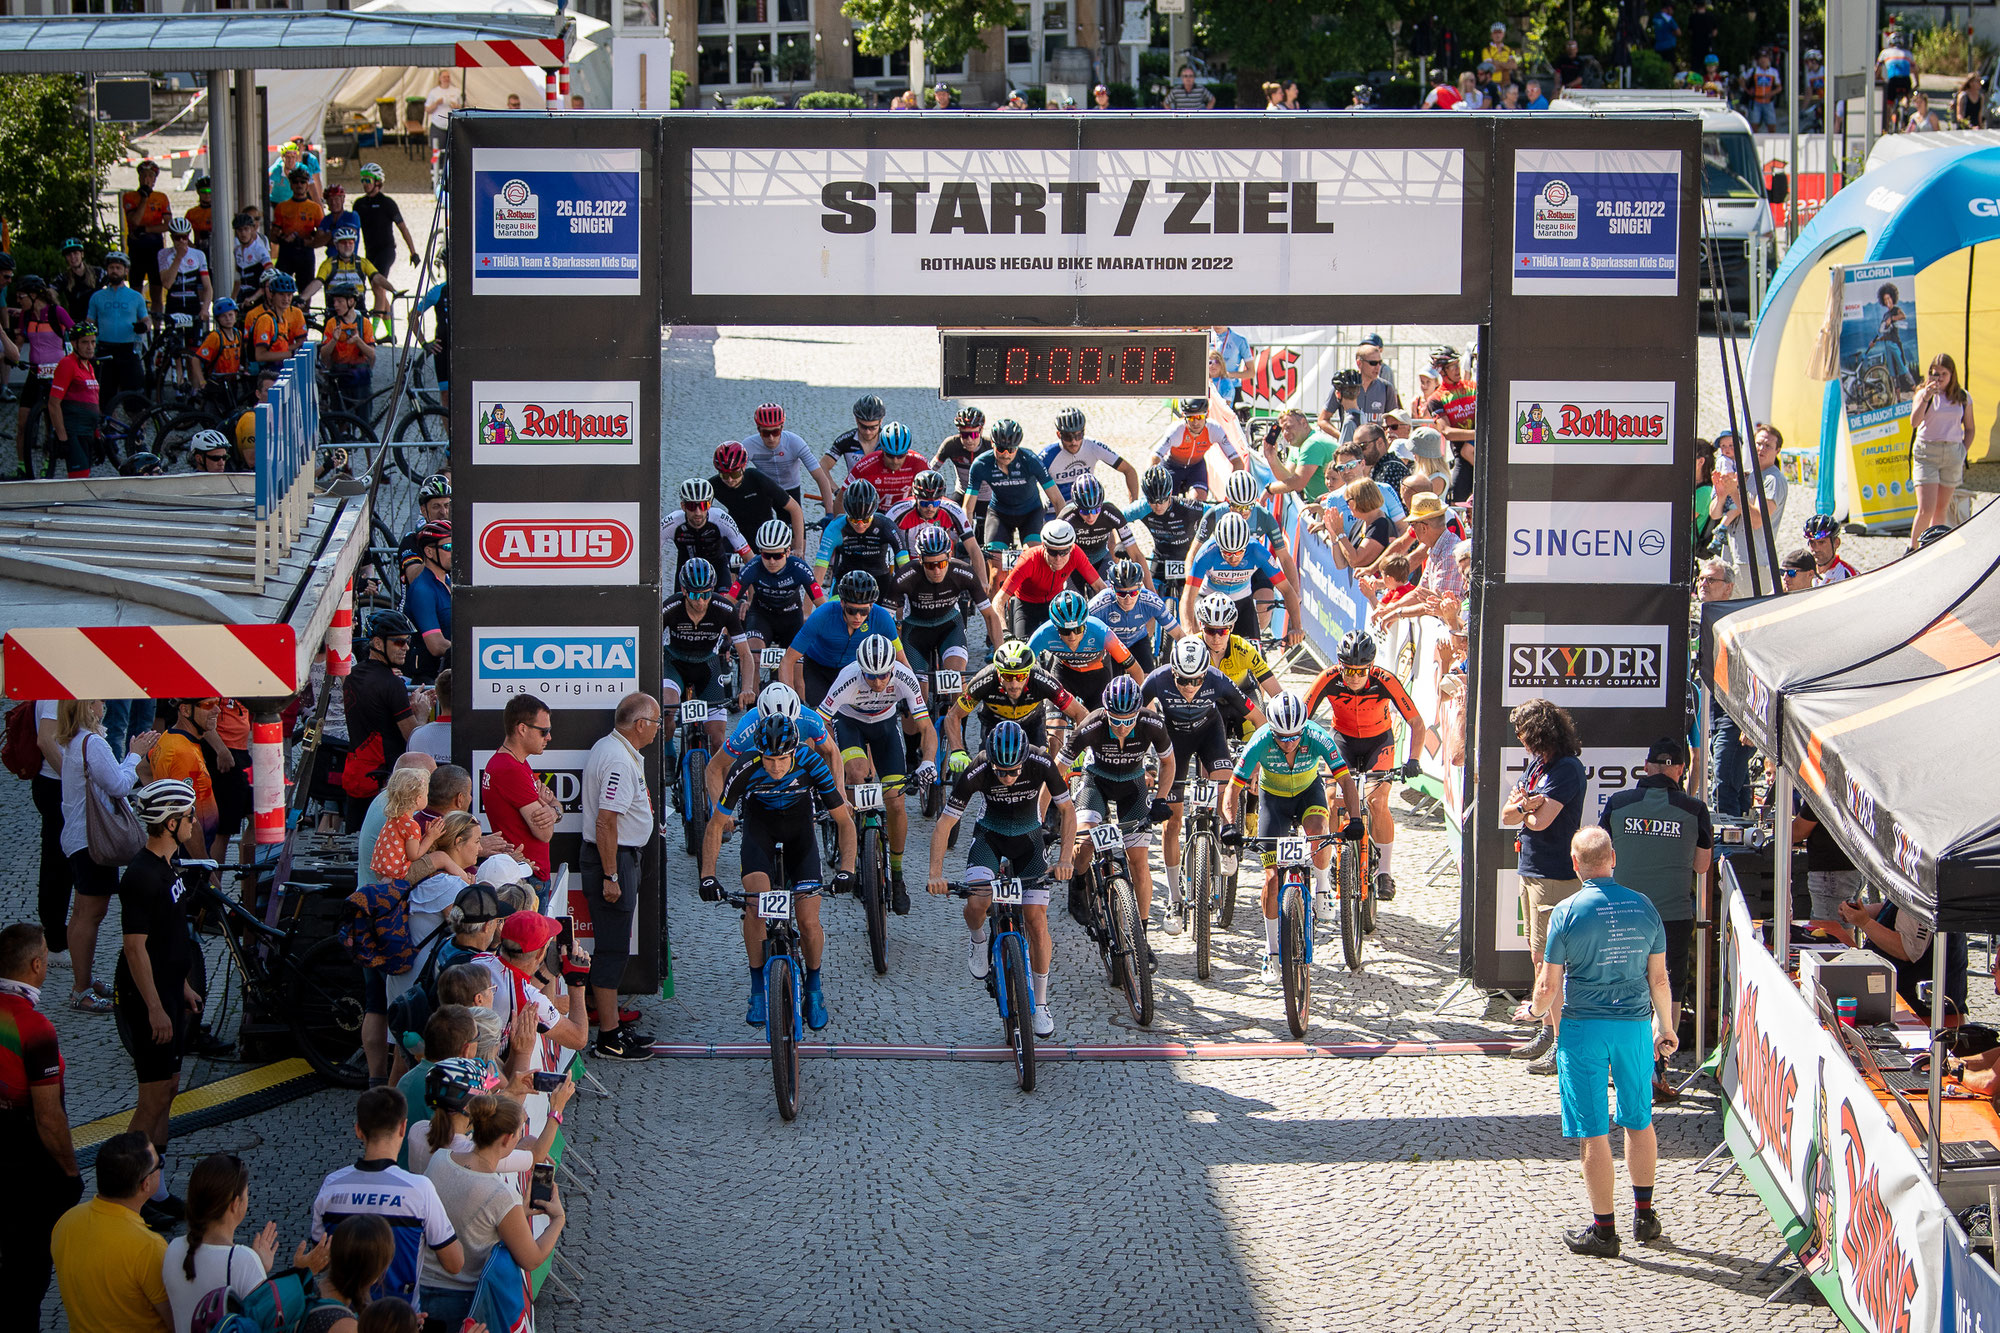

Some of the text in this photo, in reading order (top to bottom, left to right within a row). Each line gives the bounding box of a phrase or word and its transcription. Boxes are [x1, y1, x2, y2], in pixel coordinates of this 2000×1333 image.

[507, 209, 535, 220] Rothaus
[556, 200, 627, 217] 26.06.2022
[821, 180, 1100, 235] START
[1163, 181, 1334, 235] ZIEL
[1547, 210, 1575, 220] Rothaus
[1596, 201, 1665, 217] 26.06.2022
[495, 222, 536, 230] Hegau Bike
[497, 229, 534, 237] Marathon
[570, 217, 613, 234] SINGEN
[1536, 223, 1576, 231] Hegau Bike
[1609, 218, 1652, 234] SINGEN
[492, 254, 637, 270] THÜGA Team & Sparkassen Kids Cup
[921, 257, 1233, 270] ROTHAUS HEGAU BIKE MARATHON 2022
[1532, 254, 1674, 270] THÜGA Team & Sparkassen Kids Cup
[1857, 267, 1891, 280] GLORIA
[520, 404, 629, 442] Rothaus
[1556, 404, 1664, 442] Rothaus
[1850, 416, 1862, 428] DIE
[1863, 407, 1893, 425] BRAUCHT
[1056, 466, 1091, 479] radax
[499, 529, 612, 558] ABUS
[1512, 528, 1633, 557] SINGEN
[1007, 554, 1021, 568] 12
[1167, 564, 1185, 575] 126
[712, 600, 733, 612] ALWA
[481, 643, 632, 670] GLORIA
[762, 650, 782, 663] 105
[1512, 646, 1658, 678] SKYDER
[492, 681, 624, 696] Das Original
[832, 676, 858, 698] SRAM
[938, 673, 961, 690] 102
[1512, 678, 1658, 686] EVENT & TRACK COMPANY
[683, 703, 706, 719] 130
[1140, 716, 1164, 728] ALWA
[1029, 753, 1051, 768] ALWA
[967, 762, 988, 780] ALWA
[859, 788, 877, 807] 117
[1193, 785, 1215, 801] 107
[1625, 817, 1681, 835] SKYDER
[1092, 827, 1119, 846] 124
[1279, 841, 1303, 861] 125
[994, 882, 1020, 899] 104
[762, 896, 788, 914] 122
[351, 1193, 402, 1207] WEFA
